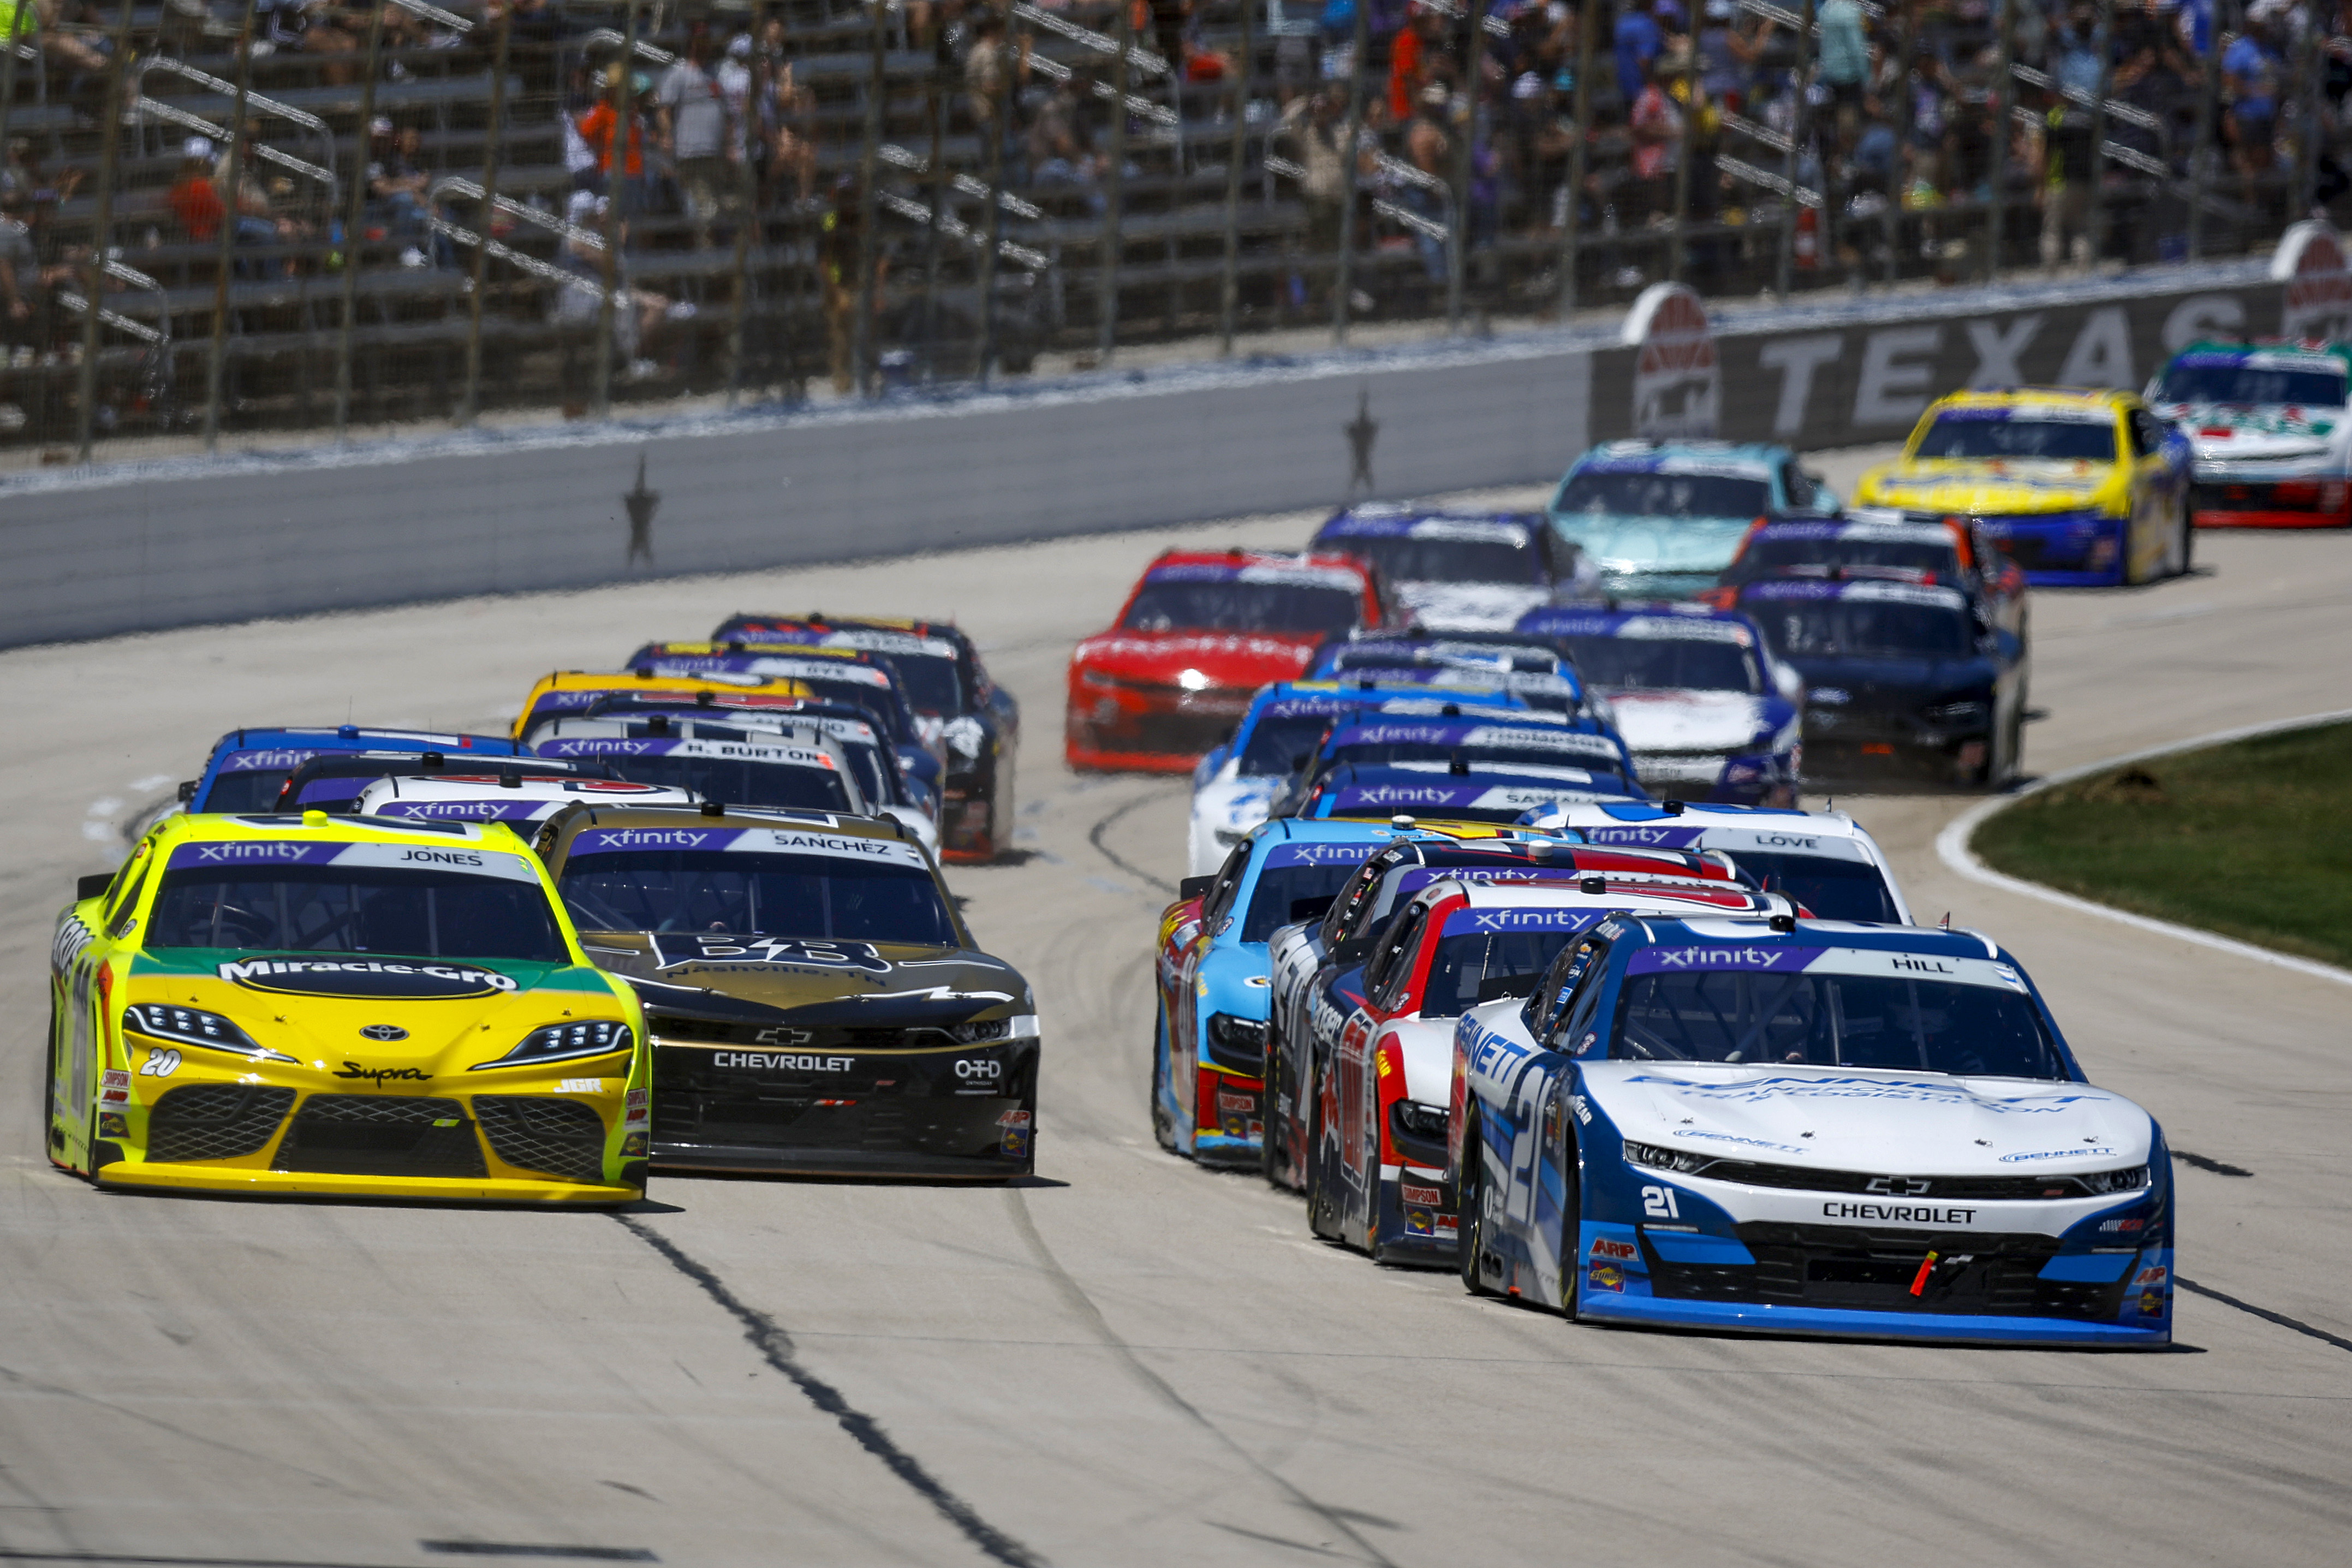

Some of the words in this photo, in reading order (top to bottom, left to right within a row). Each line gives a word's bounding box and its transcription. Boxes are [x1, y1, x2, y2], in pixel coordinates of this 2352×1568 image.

[555, 691, 603, 706] xfin
[1360, 724, 1449, 743] xfinity
[558, 740, 652, 755] xfinity
[687, 743, 712, 755] H.
[722, 746, 819, 761] BURTON
[235, 749, 314, 768] xfinit
[1359, 784, 1457, 803] xfinity
[404, 802, 511, 819] xfinity
[599, 829, 708, 847] xfinity
[775, 833, 892, 855] SANCHEZ
[1587, 827, 1670, 844] finity
[1755, 835, 1818, 849] LOVE
[199, 842, 312, 861] xfinity
[401, 849, 484, 867] JONES
[1294, 844, 1377, 862] xfinit
[1475, 909, 1592, 929] xfinity
[1660, 946, 1783, 968] xfinity
[1891, 957, 1954, 974] HILL
[219, 960, 519, 991] Miracle-Gro
[838, 970, 887, 988] TN
[139, 1047, 181, 1077] 20
[714, 1052, 856, 1072] CHEVROLET
[105, 1071, 129, 1088] SIMPSON
[332, 1060, 434, 1089] Supra
[553, 1078, 603, 1093] JGR
[2014, 1147, 2114, 1161] BENNETT
[1403, 1187, 1438, 1203] SIMPSON
[1642, 1185, 1679, 1219] 21
[1823, 1203, 1977, 1225] CHEVROLET
[1592, 1238, 1635, 1259] ARP
